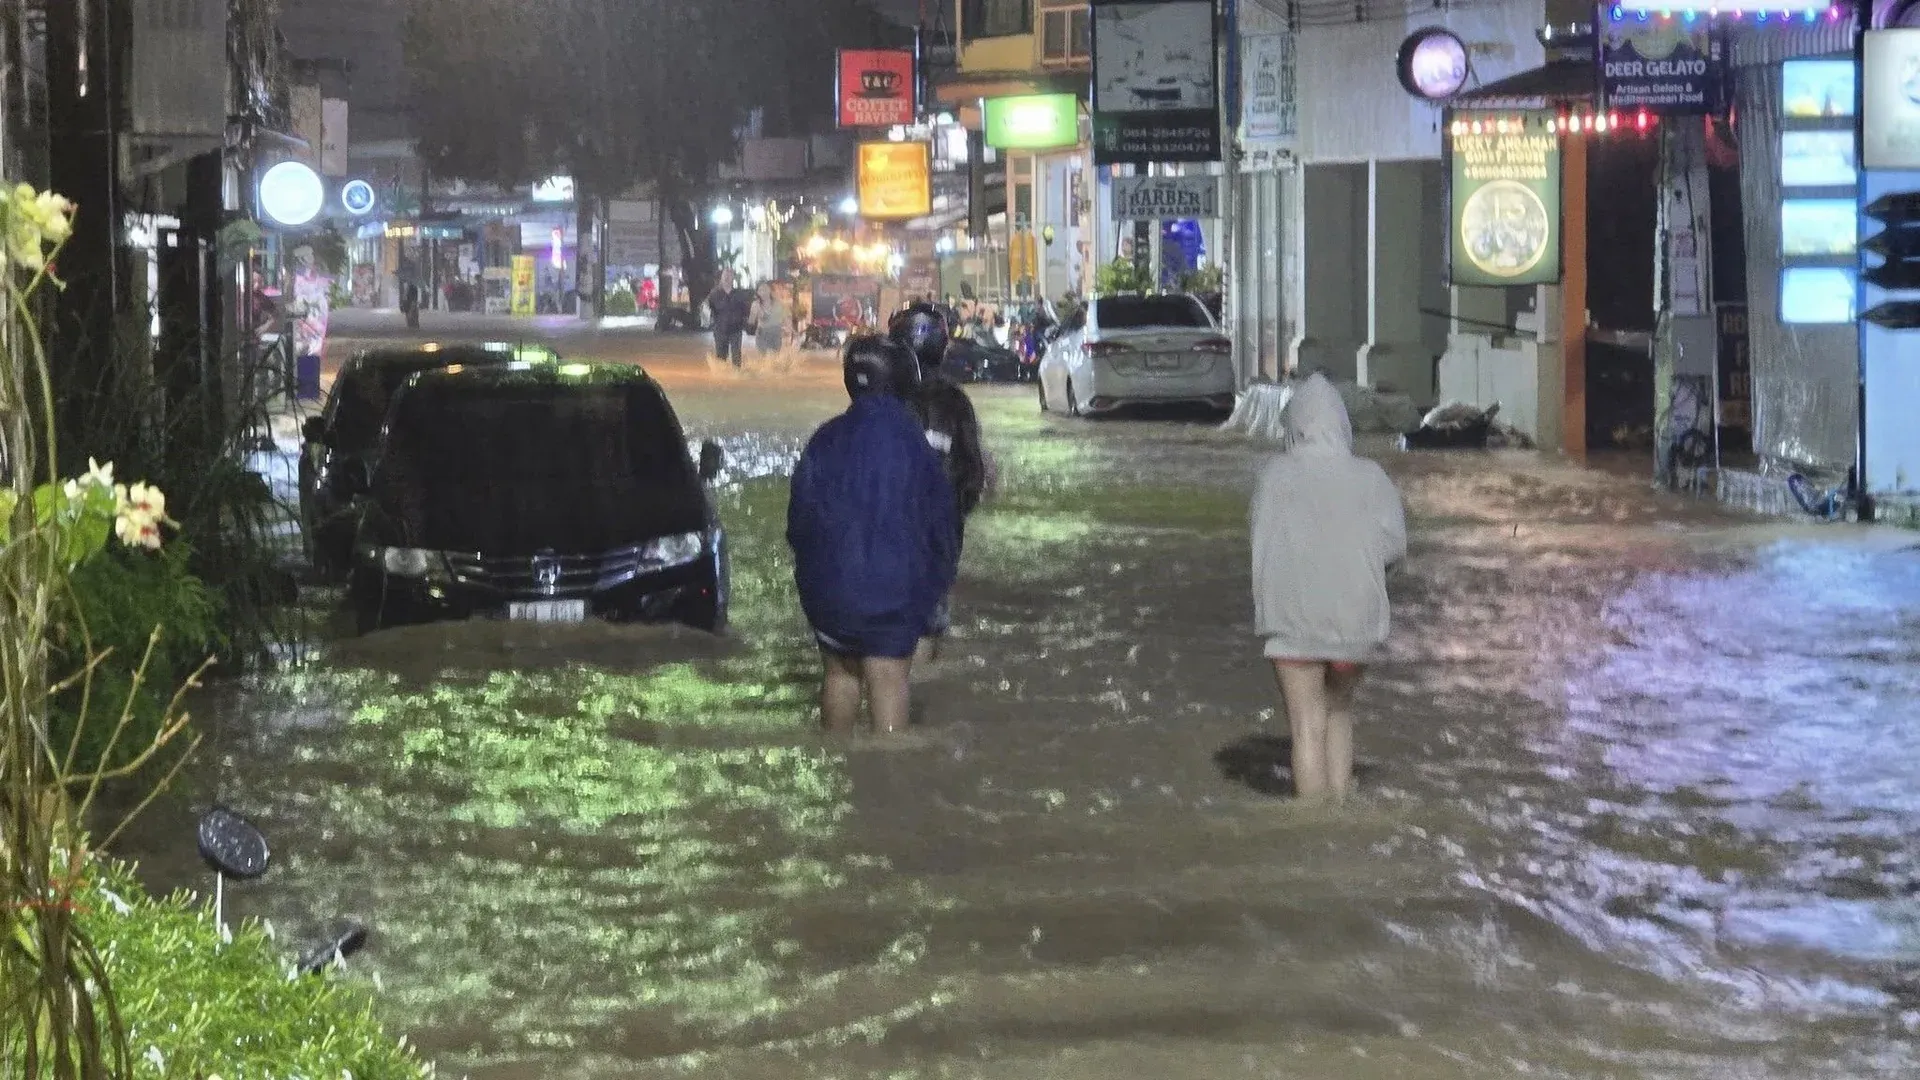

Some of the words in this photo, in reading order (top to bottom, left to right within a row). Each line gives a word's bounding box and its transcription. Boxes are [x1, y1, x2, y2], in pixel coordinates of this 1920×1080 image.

[1605, 61, 1644, 77] DEER
[1646, 59, 1706, 76] GELATO
[1679, 91, 1704, 104] Food
[1453, 134, 1493, 152] LUCKY
[1130, 188, 1201, 205] BARBER
[1159, 206, 1201, 216] SALON
